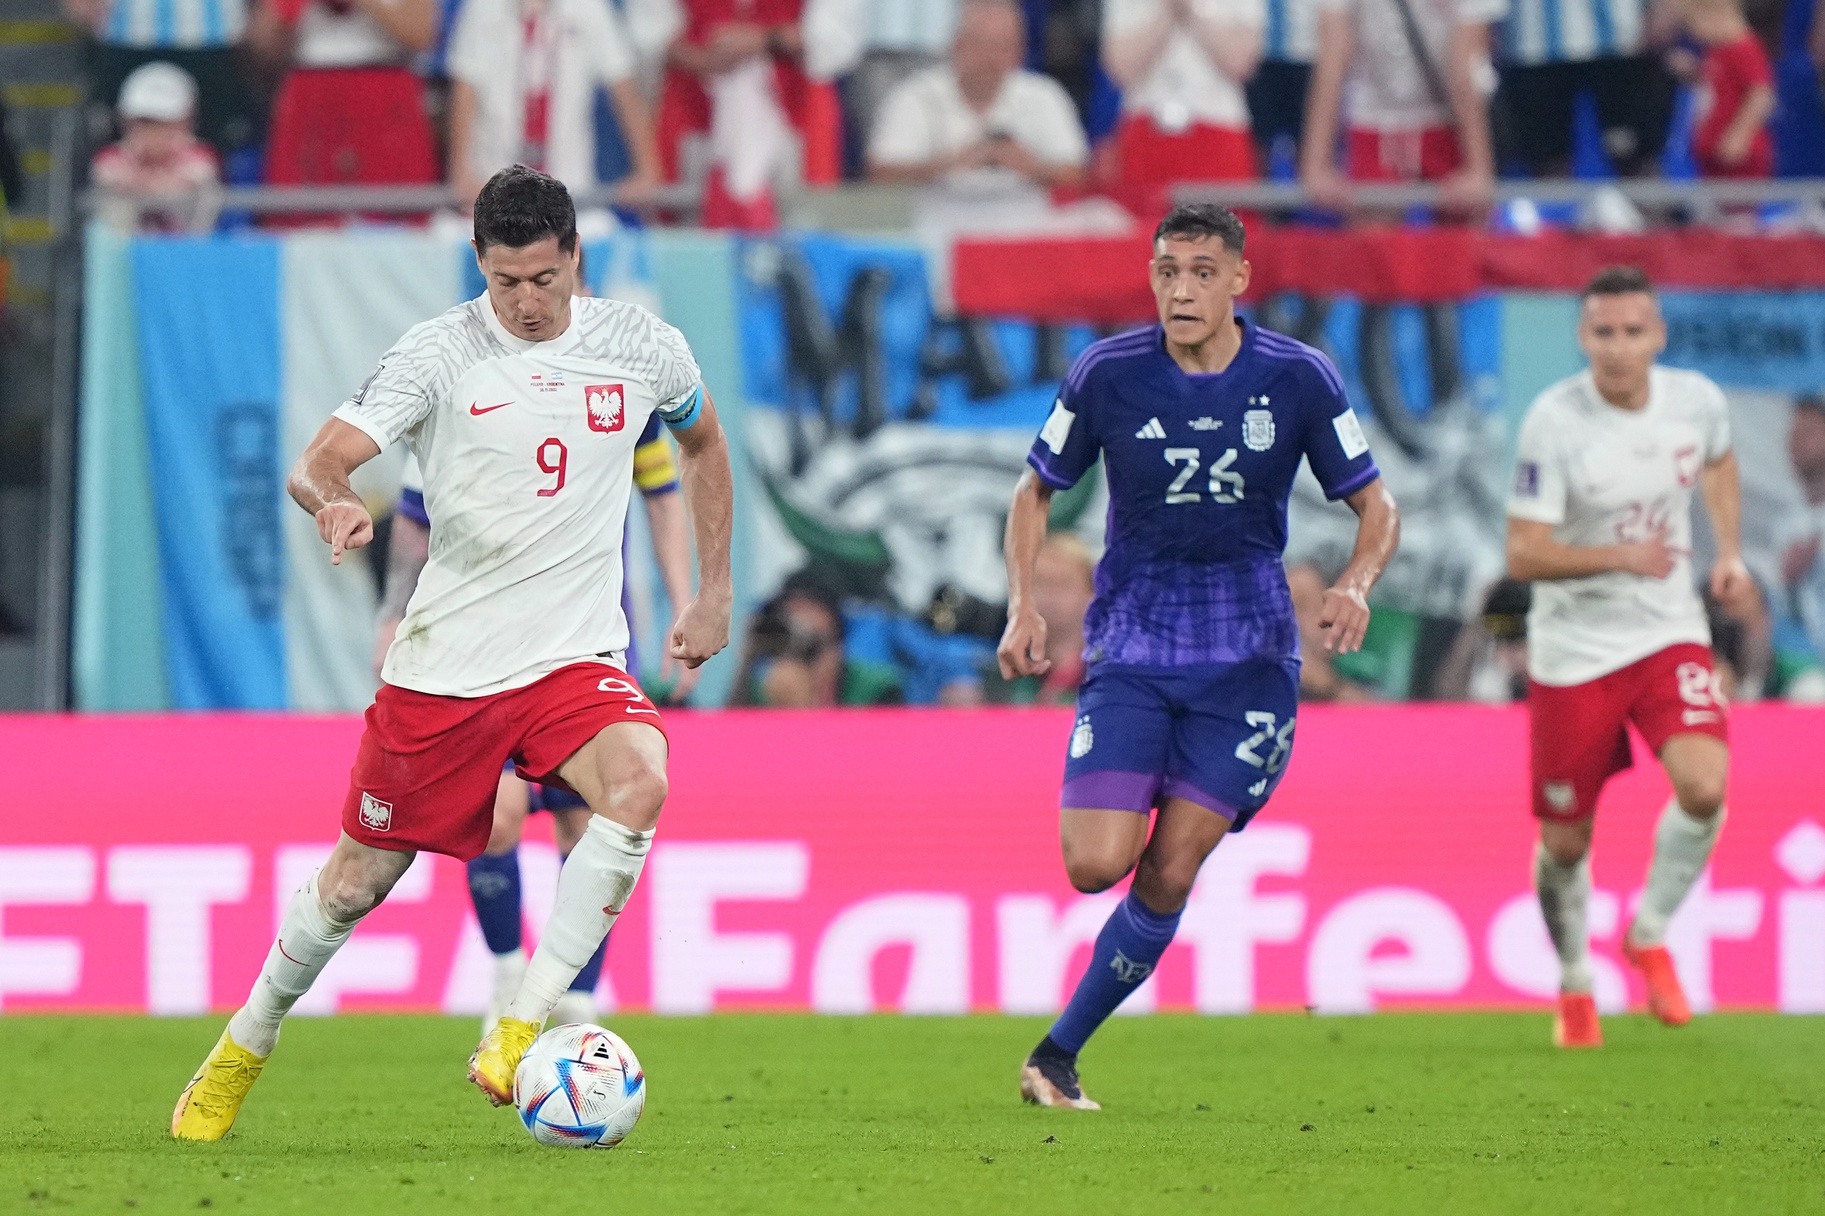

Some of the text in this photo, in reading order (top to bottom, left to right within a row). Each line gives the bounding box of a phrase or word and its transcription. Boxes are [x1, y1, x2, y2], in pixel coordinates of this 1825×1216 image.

[536, 437, 568, 497] 9
[1164, 447, 1245, 504] 26
[597, 677, 644, 702] 9
[1234, 711, 1296, 774] 26
